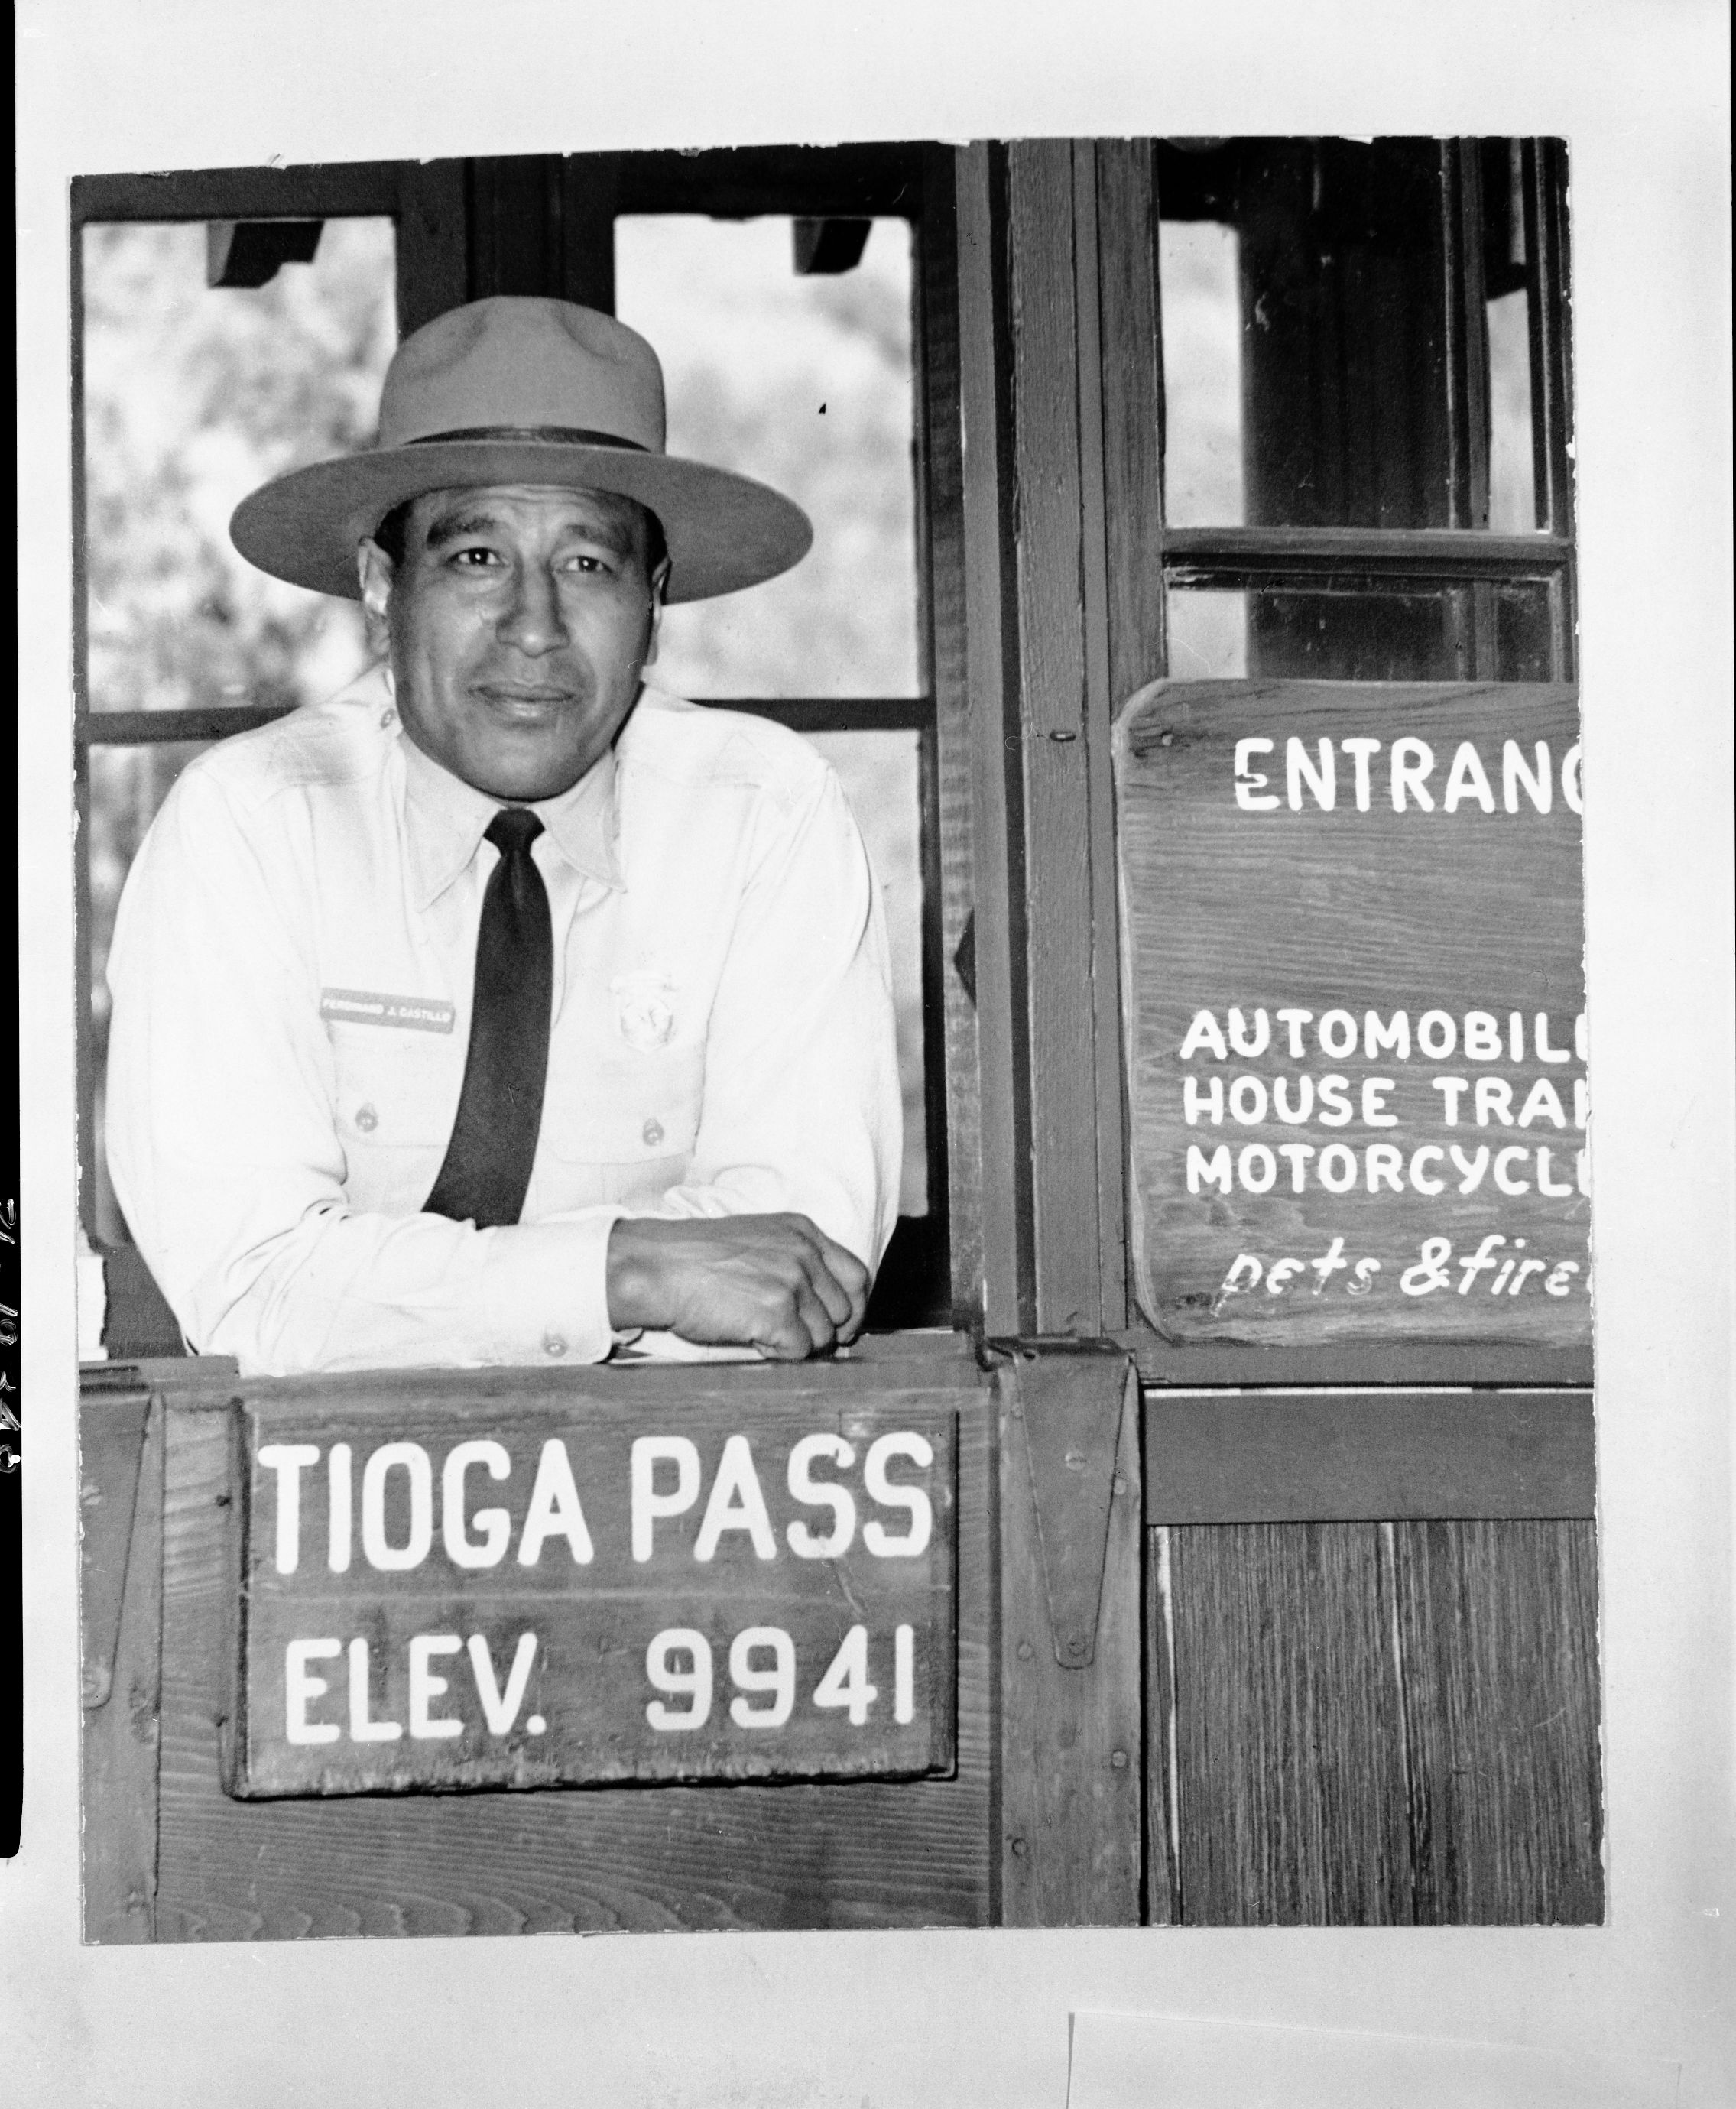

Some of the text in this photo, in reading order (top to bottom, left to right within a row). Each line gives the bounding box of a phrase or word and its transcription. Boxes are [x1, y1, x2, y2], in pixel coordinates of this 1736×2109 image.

[1183, 1074, 1398, 1127] HOUSE
[1210, 1237, 1381, 1317] pets
[258, 1432, 933, 1575] TIOGA PASS
[285, 1624, 913, 1745] ELEV. 9941
